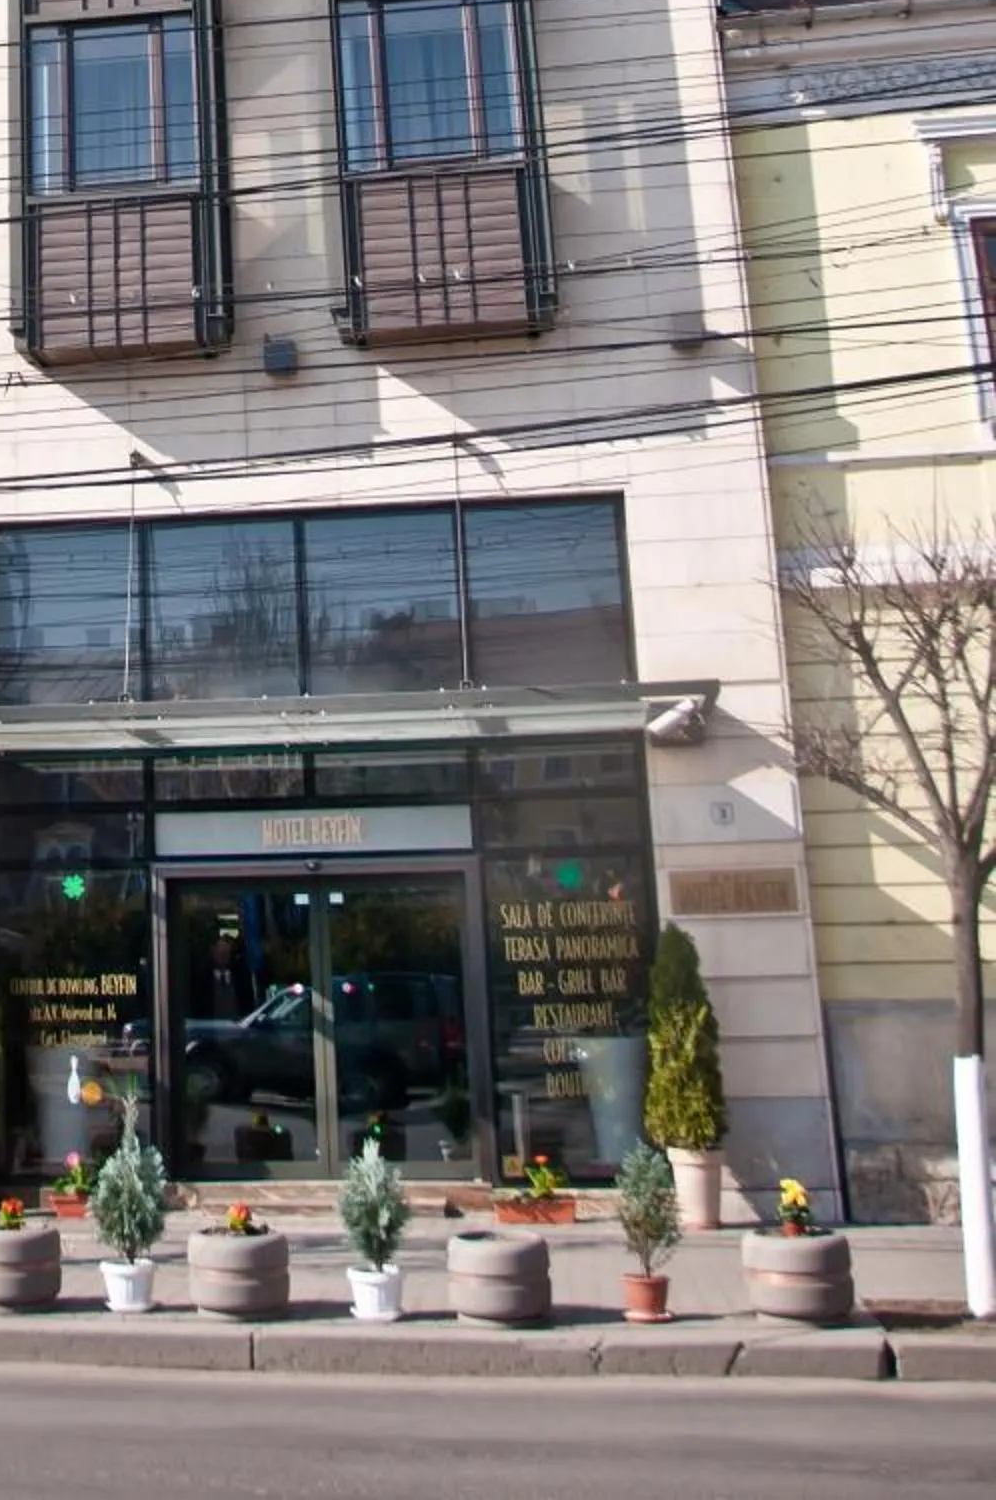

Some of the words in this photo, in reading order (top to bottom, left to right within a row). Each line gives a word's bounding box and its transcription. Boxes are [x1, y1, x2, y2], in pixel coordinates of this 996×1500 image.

[263, 817, 308, 848] HOTEL
[538, 901, 554, 928] DE
[58, 978, 98, 995] BOWLING
[100, 973, 137, 996] BEYFIN
[517, 970, 546, 996] BAR
[557, 968, 596, 996] GRILL
[600, 967, 627, 994] BAR
[533, 1002, 613, 1028] RESTAURANT
